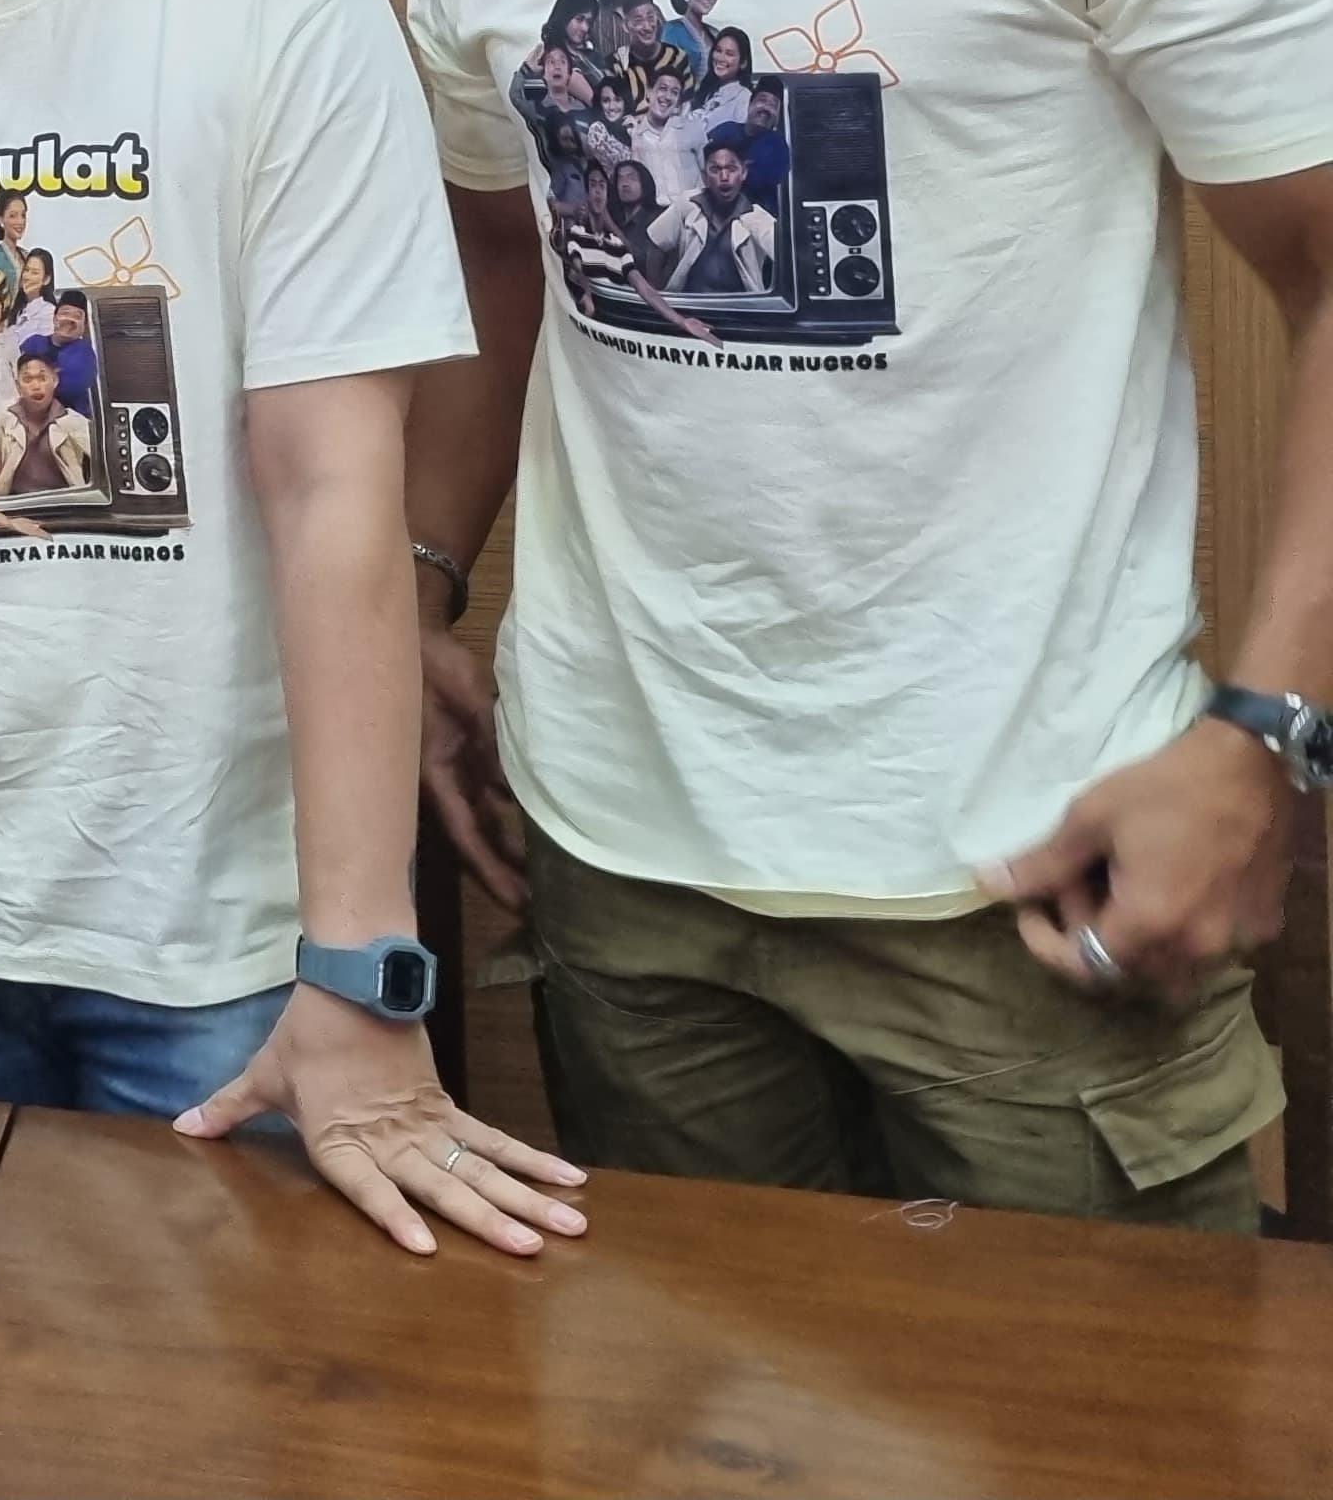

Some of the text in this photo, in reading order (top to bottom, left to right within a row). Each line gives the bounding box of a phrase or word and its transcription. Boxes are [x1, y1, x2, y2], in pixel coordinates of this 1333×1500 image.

[646, 343, 710, 368] KARYA
[715, 352, 783, 371] FAJAR
[47, 544, 106, 560] FAJAR
